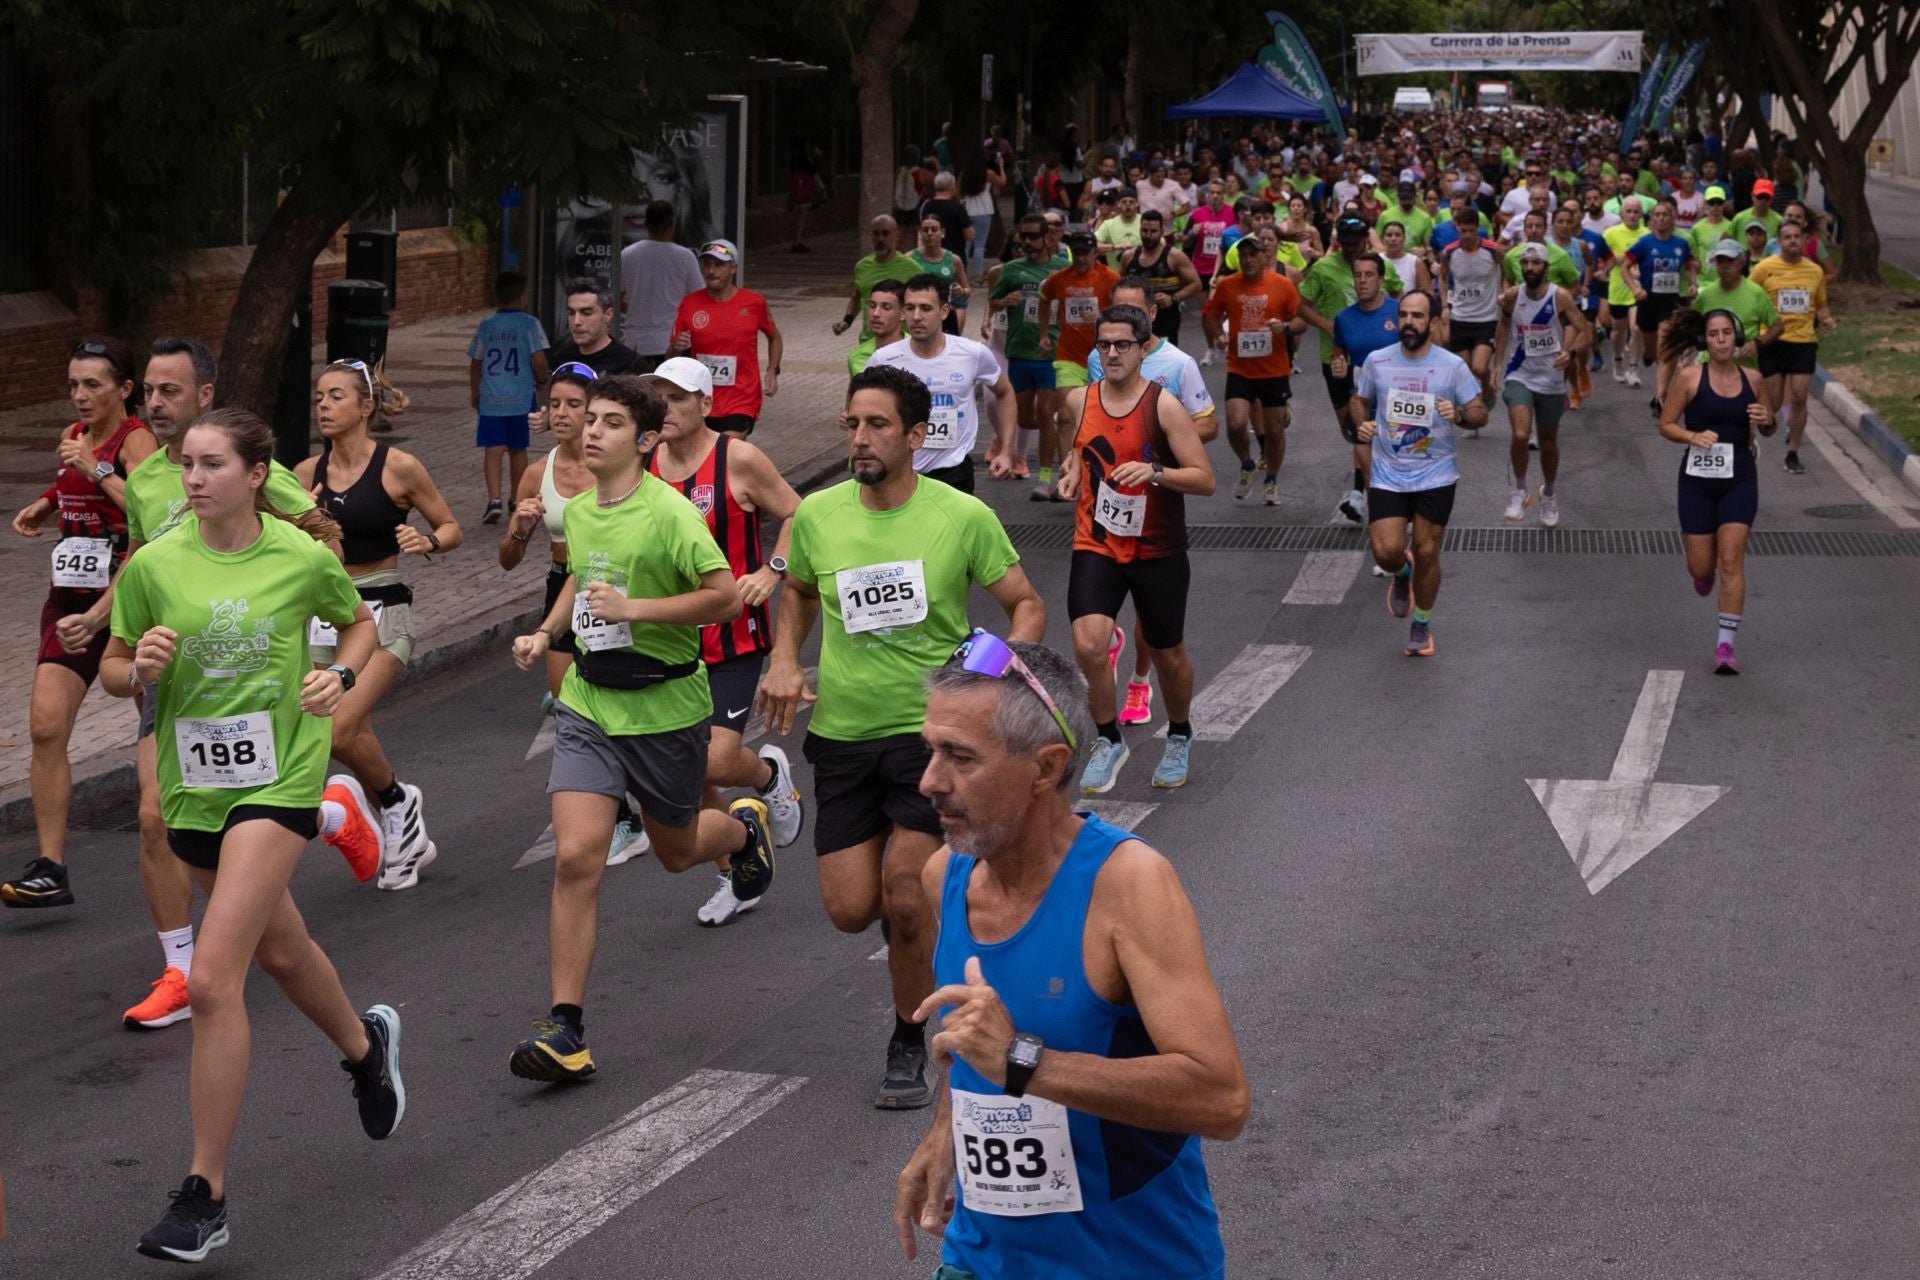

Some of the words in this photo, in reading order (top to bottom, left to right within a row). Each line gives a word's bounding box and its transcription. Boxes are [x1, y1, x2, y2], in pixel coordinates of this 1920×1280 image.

[1429, 37, 1482, 48] Carrera
[1486, 36, 1503, 47] de
[1507, 36, 1519, 46] la
[1522, 35, 1571, 46] Prensa
[1528, 336, 1554, 349] 940
[486, 347, 520, 377] 24
[706, 364, 730, 377] 74
[1393, 401, 1426, 416] 509
[1693, 455, 1725, 467] 259
[1102, 498, 1134, 525] 871
[55, 554, 99, 572] 548
[847, 581, 915, 608] 1025
[576, 611, 619, 631] 102
[189, 740, 257, 767] 198
[963, 1133, 1048, 1179] 583
